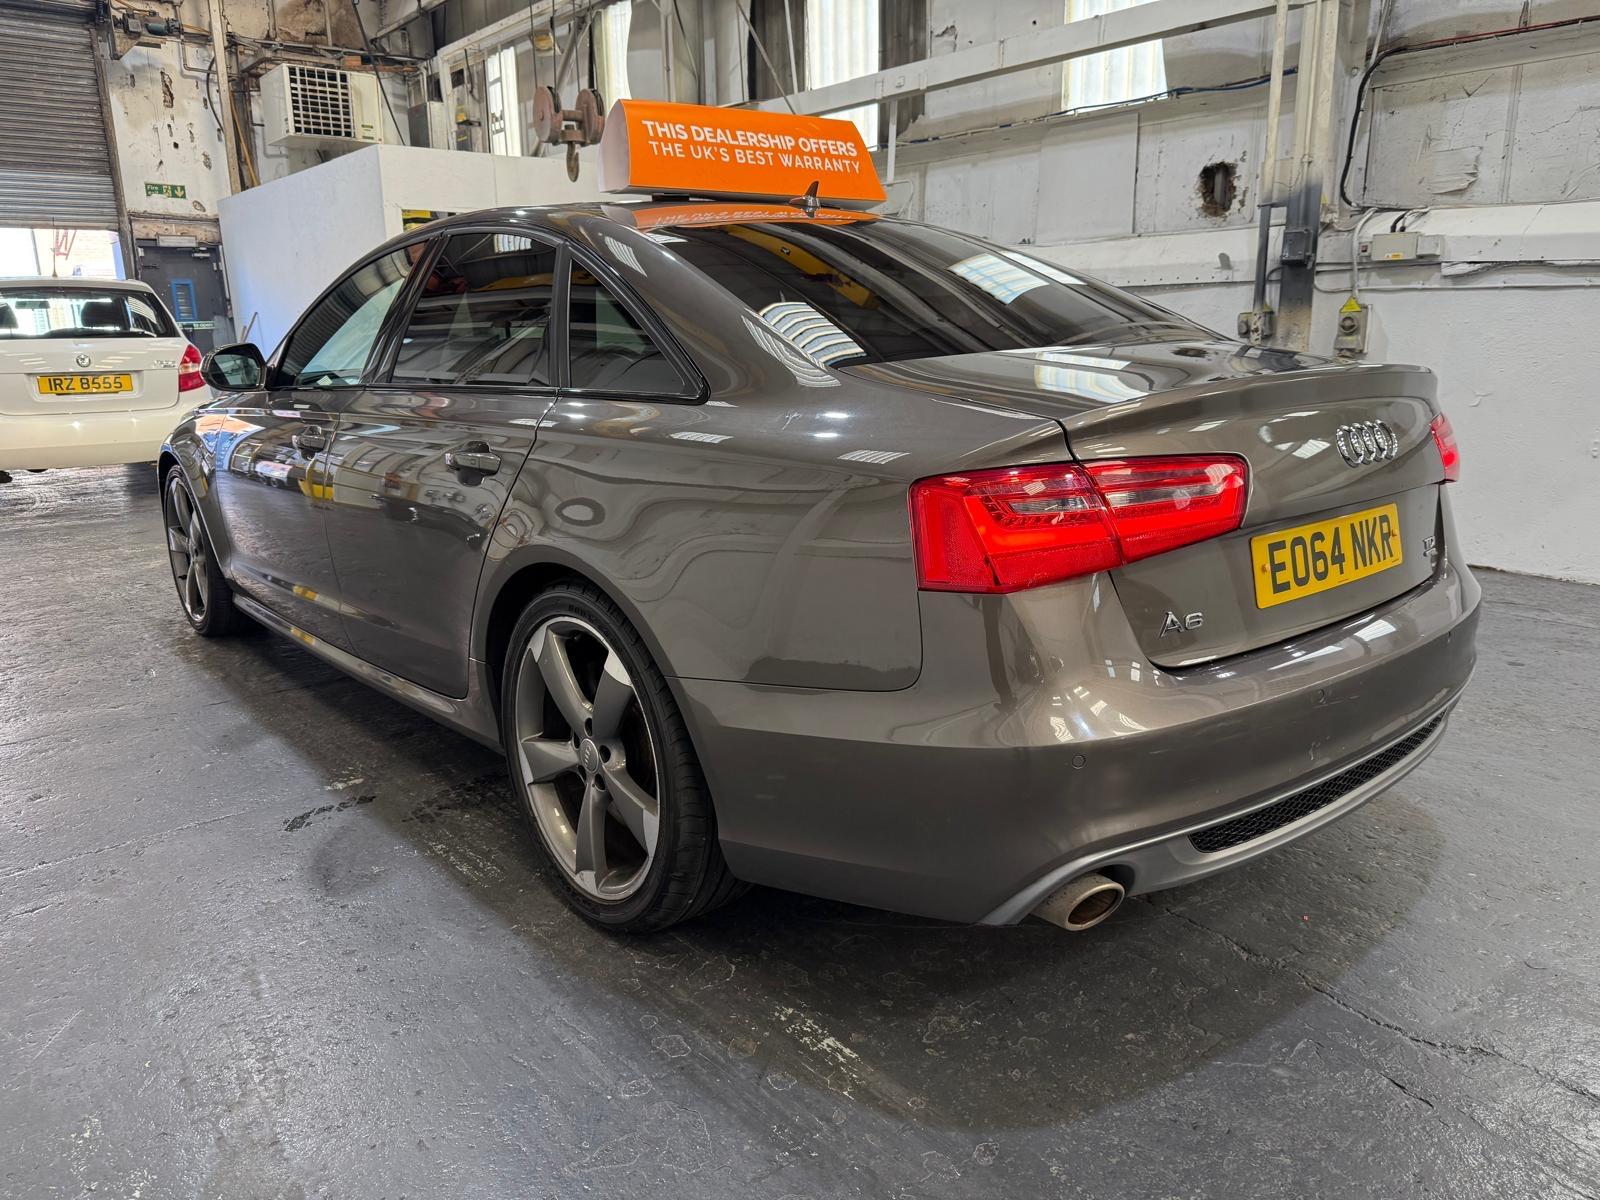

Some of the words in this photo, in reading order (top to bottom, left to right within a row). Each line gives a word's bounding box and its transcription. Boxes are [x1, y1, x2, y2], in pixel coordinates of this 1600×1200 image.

[641, 119, 688, 140] THIS
[690, 125, 795, 151] DEALERSHIP
[798, 137, 858, 157] OFFERS
[648, 140, 685, 158] THE
[689, 144, 730, 162] UK'S
[734, 149, 773, 166] BEST
[778, 153, 860, 174] WARRANTY
[47, 377, 76, 391] IRZ
[80, 376, 123, 390] 8555
[1267, 526, 1346, 595] EO64
[1349, 514, 1394, 570] NKR
[1160, 611, 1204, 638] A6
